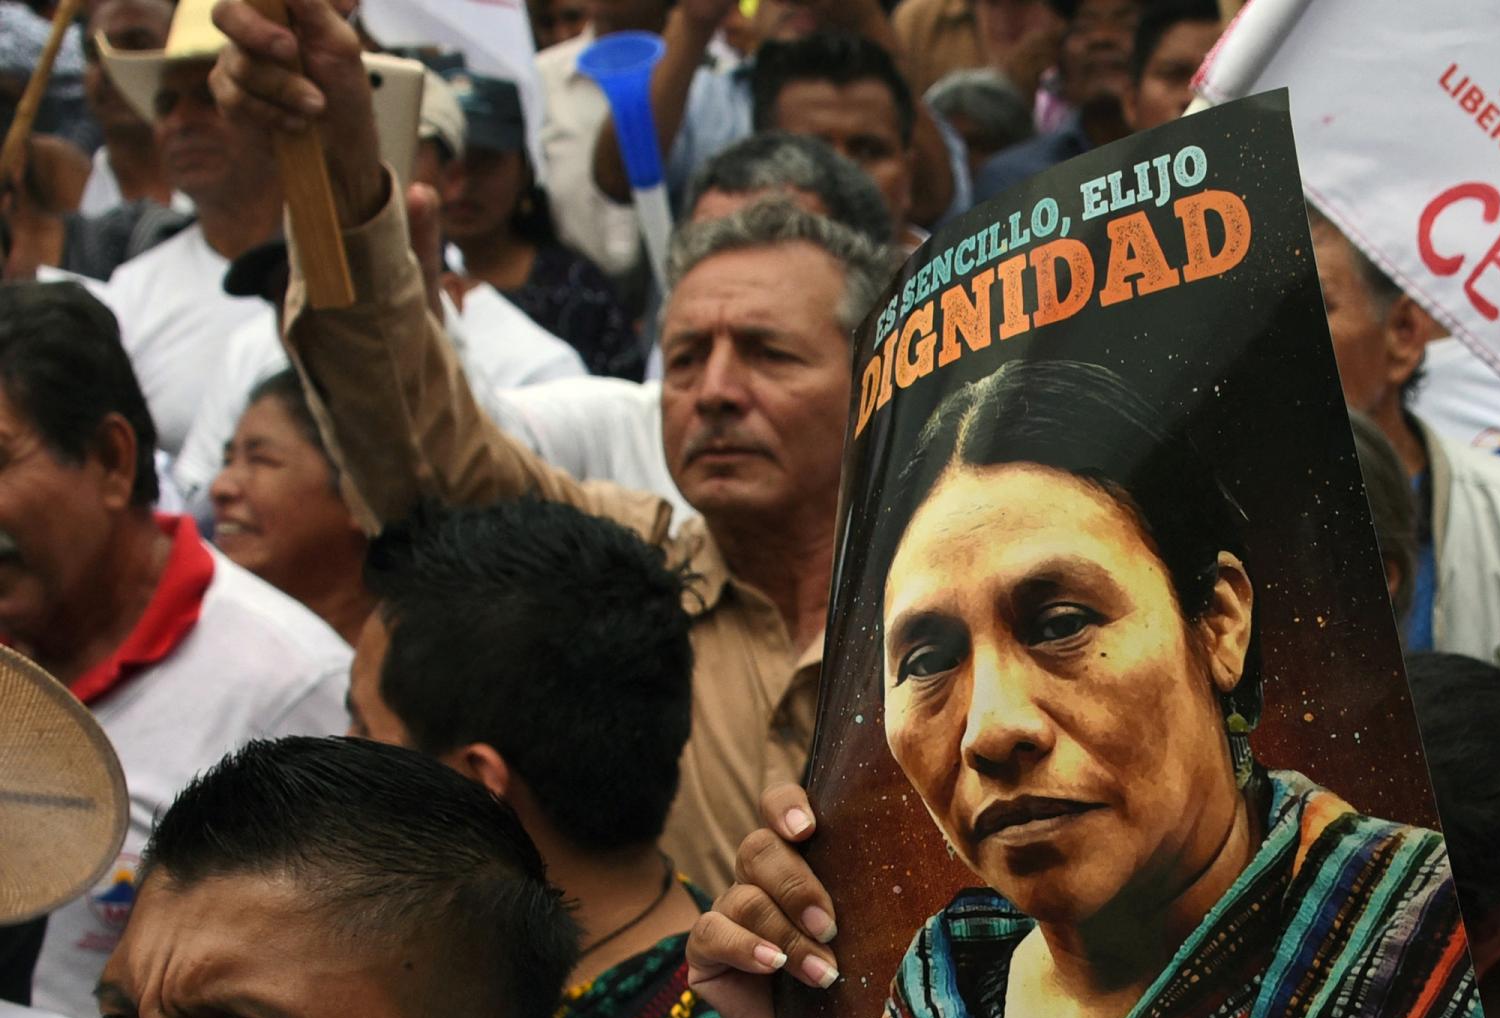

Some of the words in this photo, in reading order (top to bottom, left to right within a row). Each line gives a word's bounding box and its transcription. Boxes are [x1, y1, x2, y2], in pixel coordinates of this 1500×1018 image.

[854, 188, 1252, 440] DIGNIDAD
[873, 294, 898, 349] ES
[899, 197, 1071, 318] SENCILLO,
[1080, 145, 1208, 221] ELIJO
